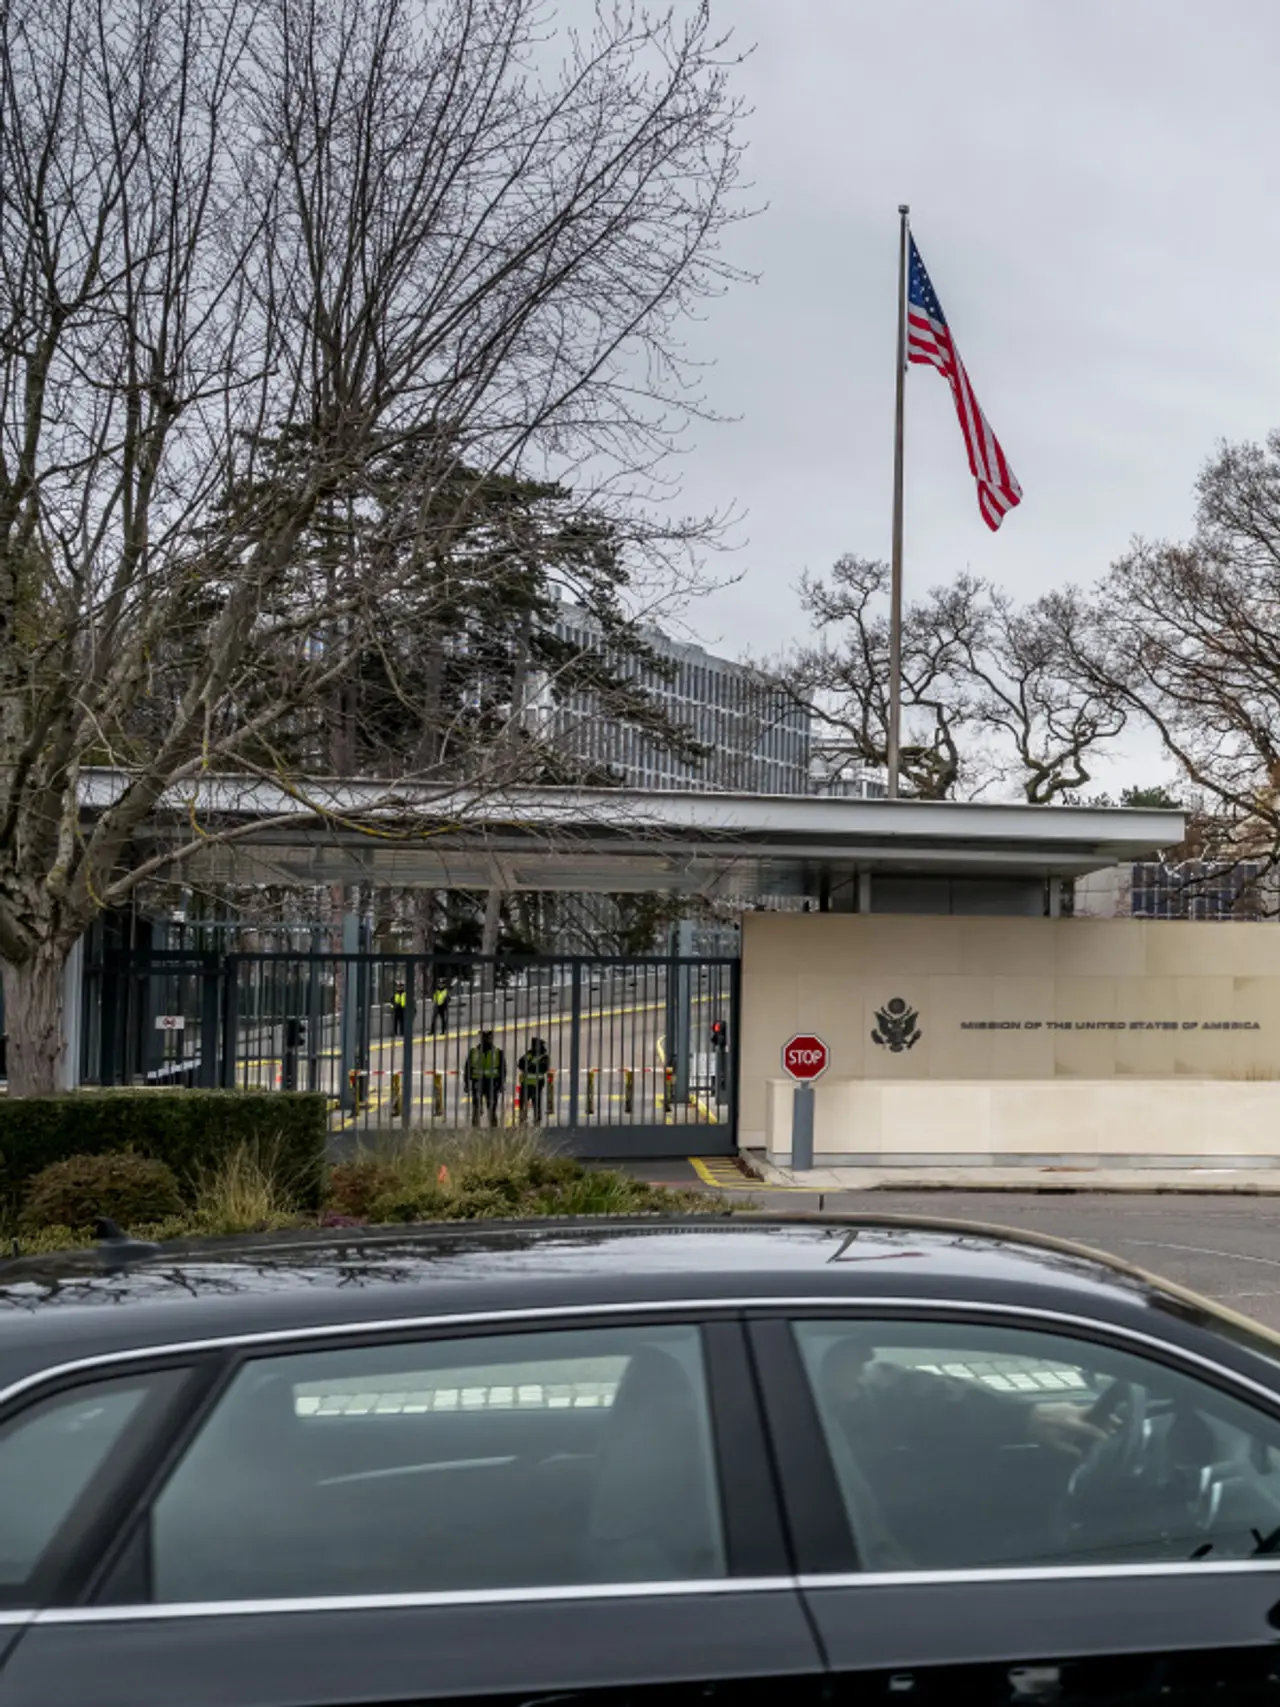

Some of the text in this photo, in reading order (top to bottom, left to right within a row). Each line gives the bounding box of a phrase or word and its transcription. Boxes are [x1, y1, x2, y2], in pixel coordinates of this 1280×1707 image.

[960, 1021, 1261, 1030] MISSION OF THE UNITED STATES OF AMERICA
[788, 1049, 822, 1065] STOP
